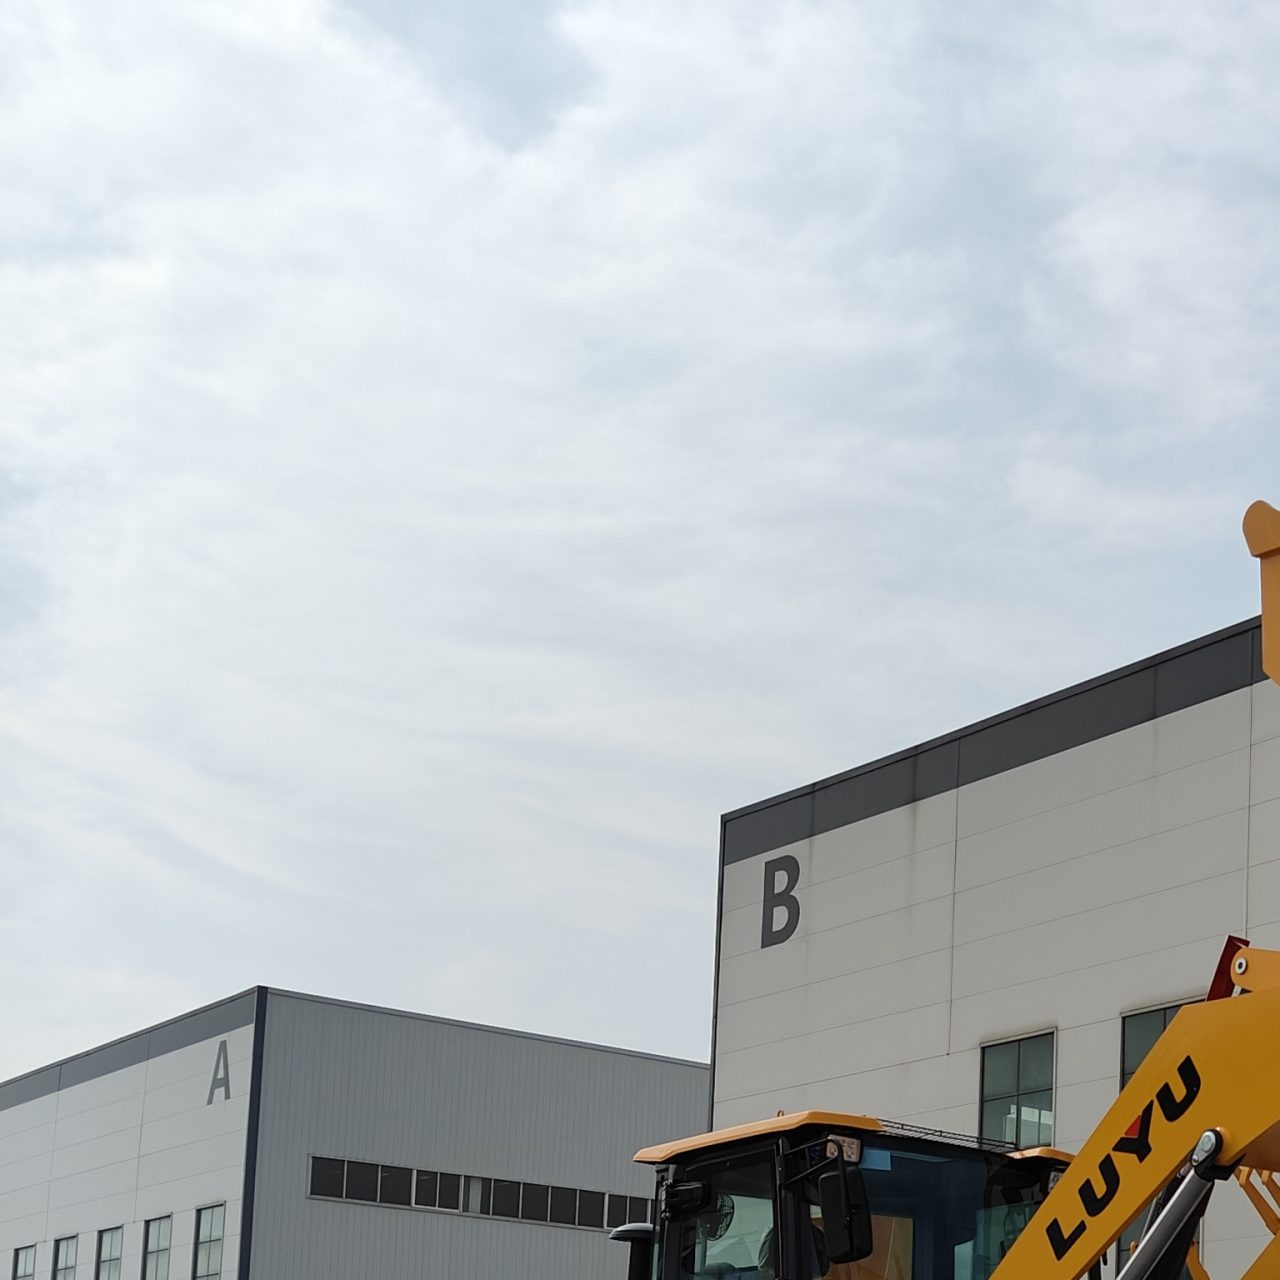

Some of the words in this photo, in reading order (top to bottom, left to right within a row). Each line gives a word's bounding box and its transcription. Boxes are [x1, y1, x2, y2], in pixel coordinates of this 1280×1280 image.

[761, 854, 800, 949] B
[206, 1039, 231, 1106] A
[1045, 1055, 1202, 1262] LUYU
